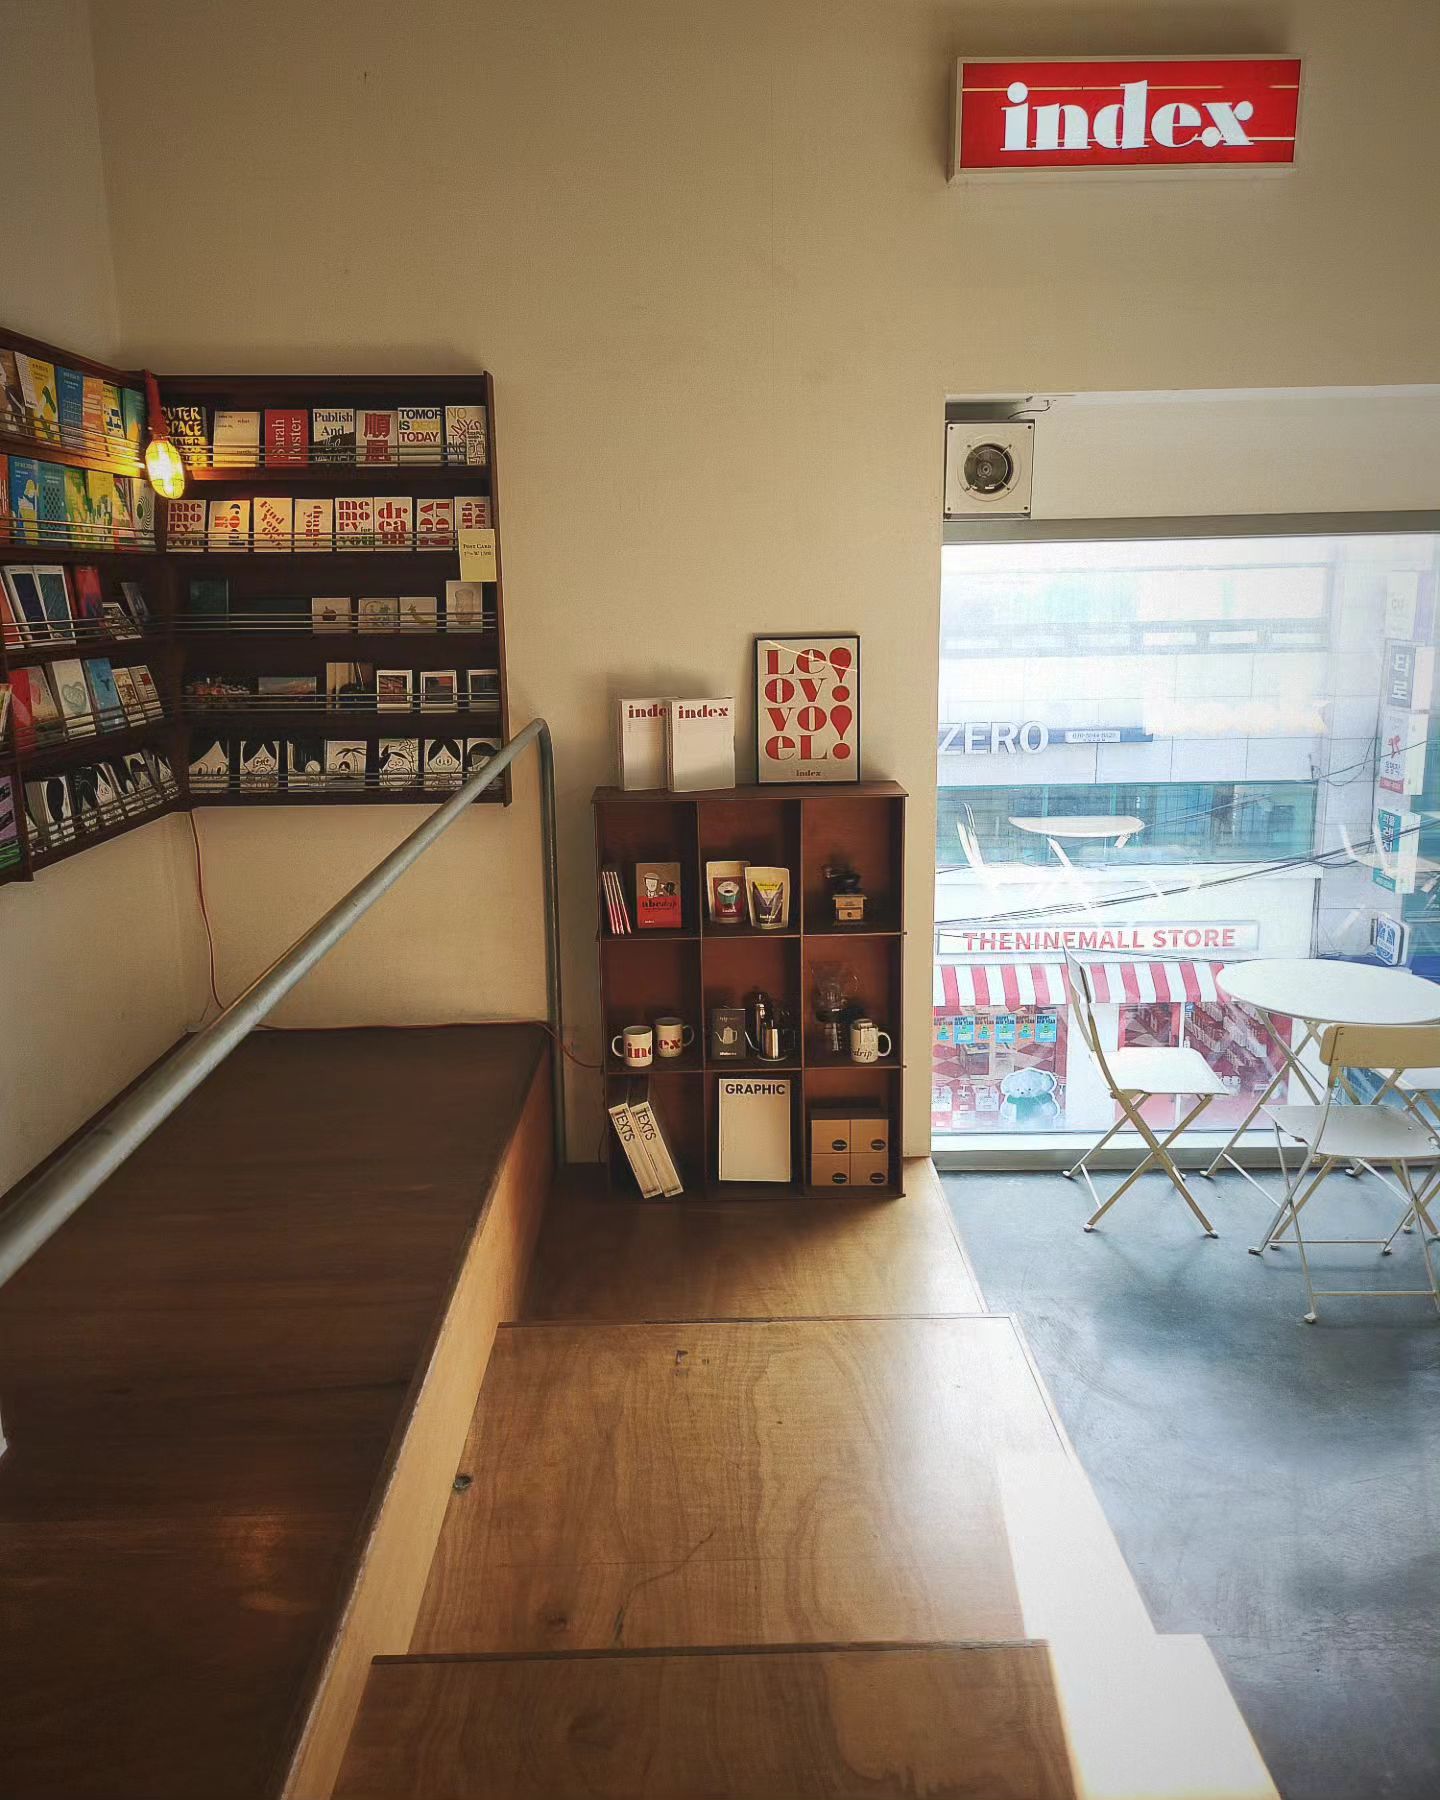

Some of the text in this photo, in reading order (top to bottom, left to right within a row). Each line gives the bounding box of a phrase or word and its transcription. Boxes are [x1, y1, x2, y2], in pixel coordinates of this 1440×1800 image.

[1000, 80, 1254, 151] index
[314, 412, 353, 422] Publish
[321, 425, 344, 436] And
[400, 432, 439, 442] TODAY
[338, 511, 370, 521] mo
[678, 704, 729, 719] index
[938, 721, 1049, 755] ZERO
[962, 928, 1237, 951] THENINEMALL STORE
[725, 1083, 786, 1095] GRAPHIC
[614, 1108, 636, 1142] TEXTS
[635, 1107, 657, 1141] TEXTS
